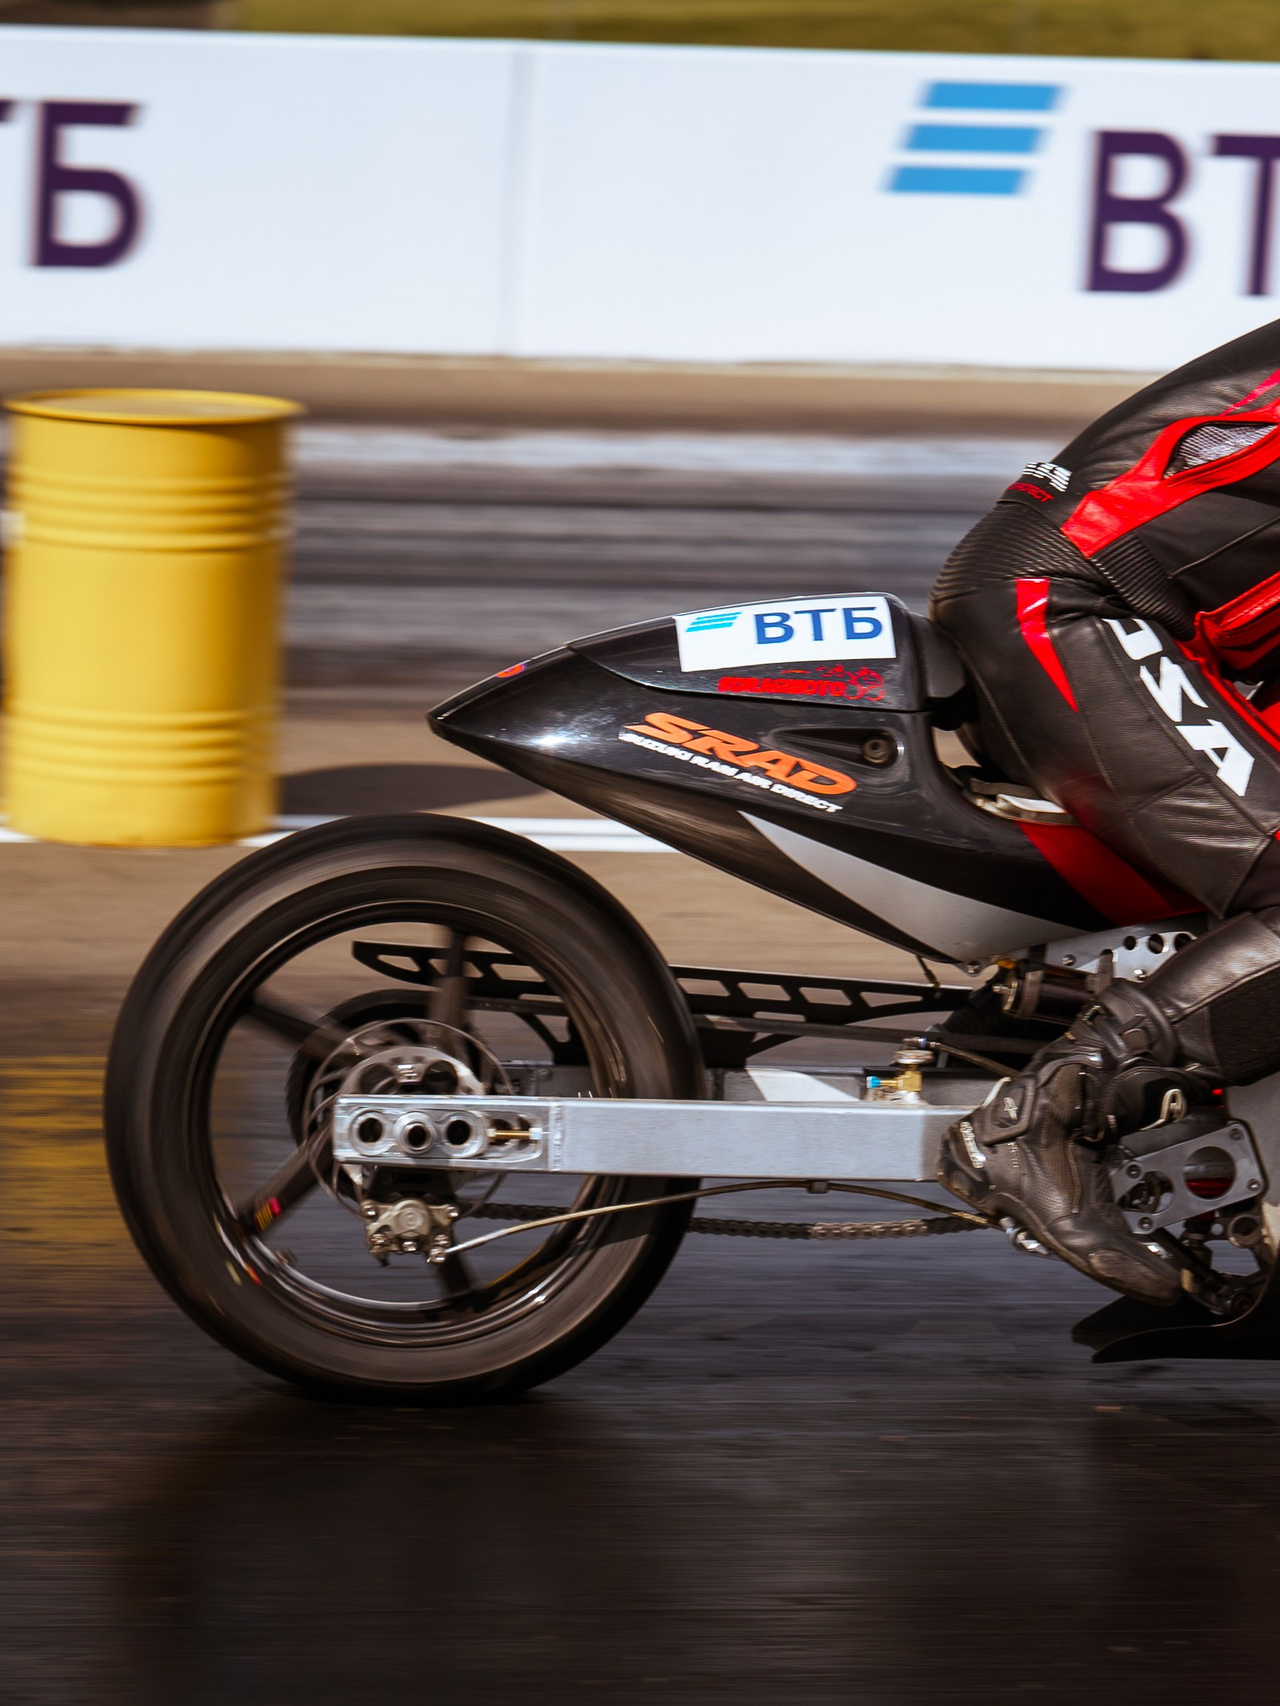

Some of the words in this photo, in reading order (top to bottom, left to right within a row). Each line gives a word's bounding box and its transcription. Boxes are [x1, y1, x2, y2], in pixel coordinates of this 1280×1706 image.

[0, 99, 145, 268] Б
[754, 606, 883, 645] ВТБ
[618, 731, 693, 762] SUZUKI
[690, 754, 739, 777] RAM
[735, 771, 773, 789] AIR
[769, 783, 844, 813] DIRECT
[624, 712, 858, 795] SRAD
